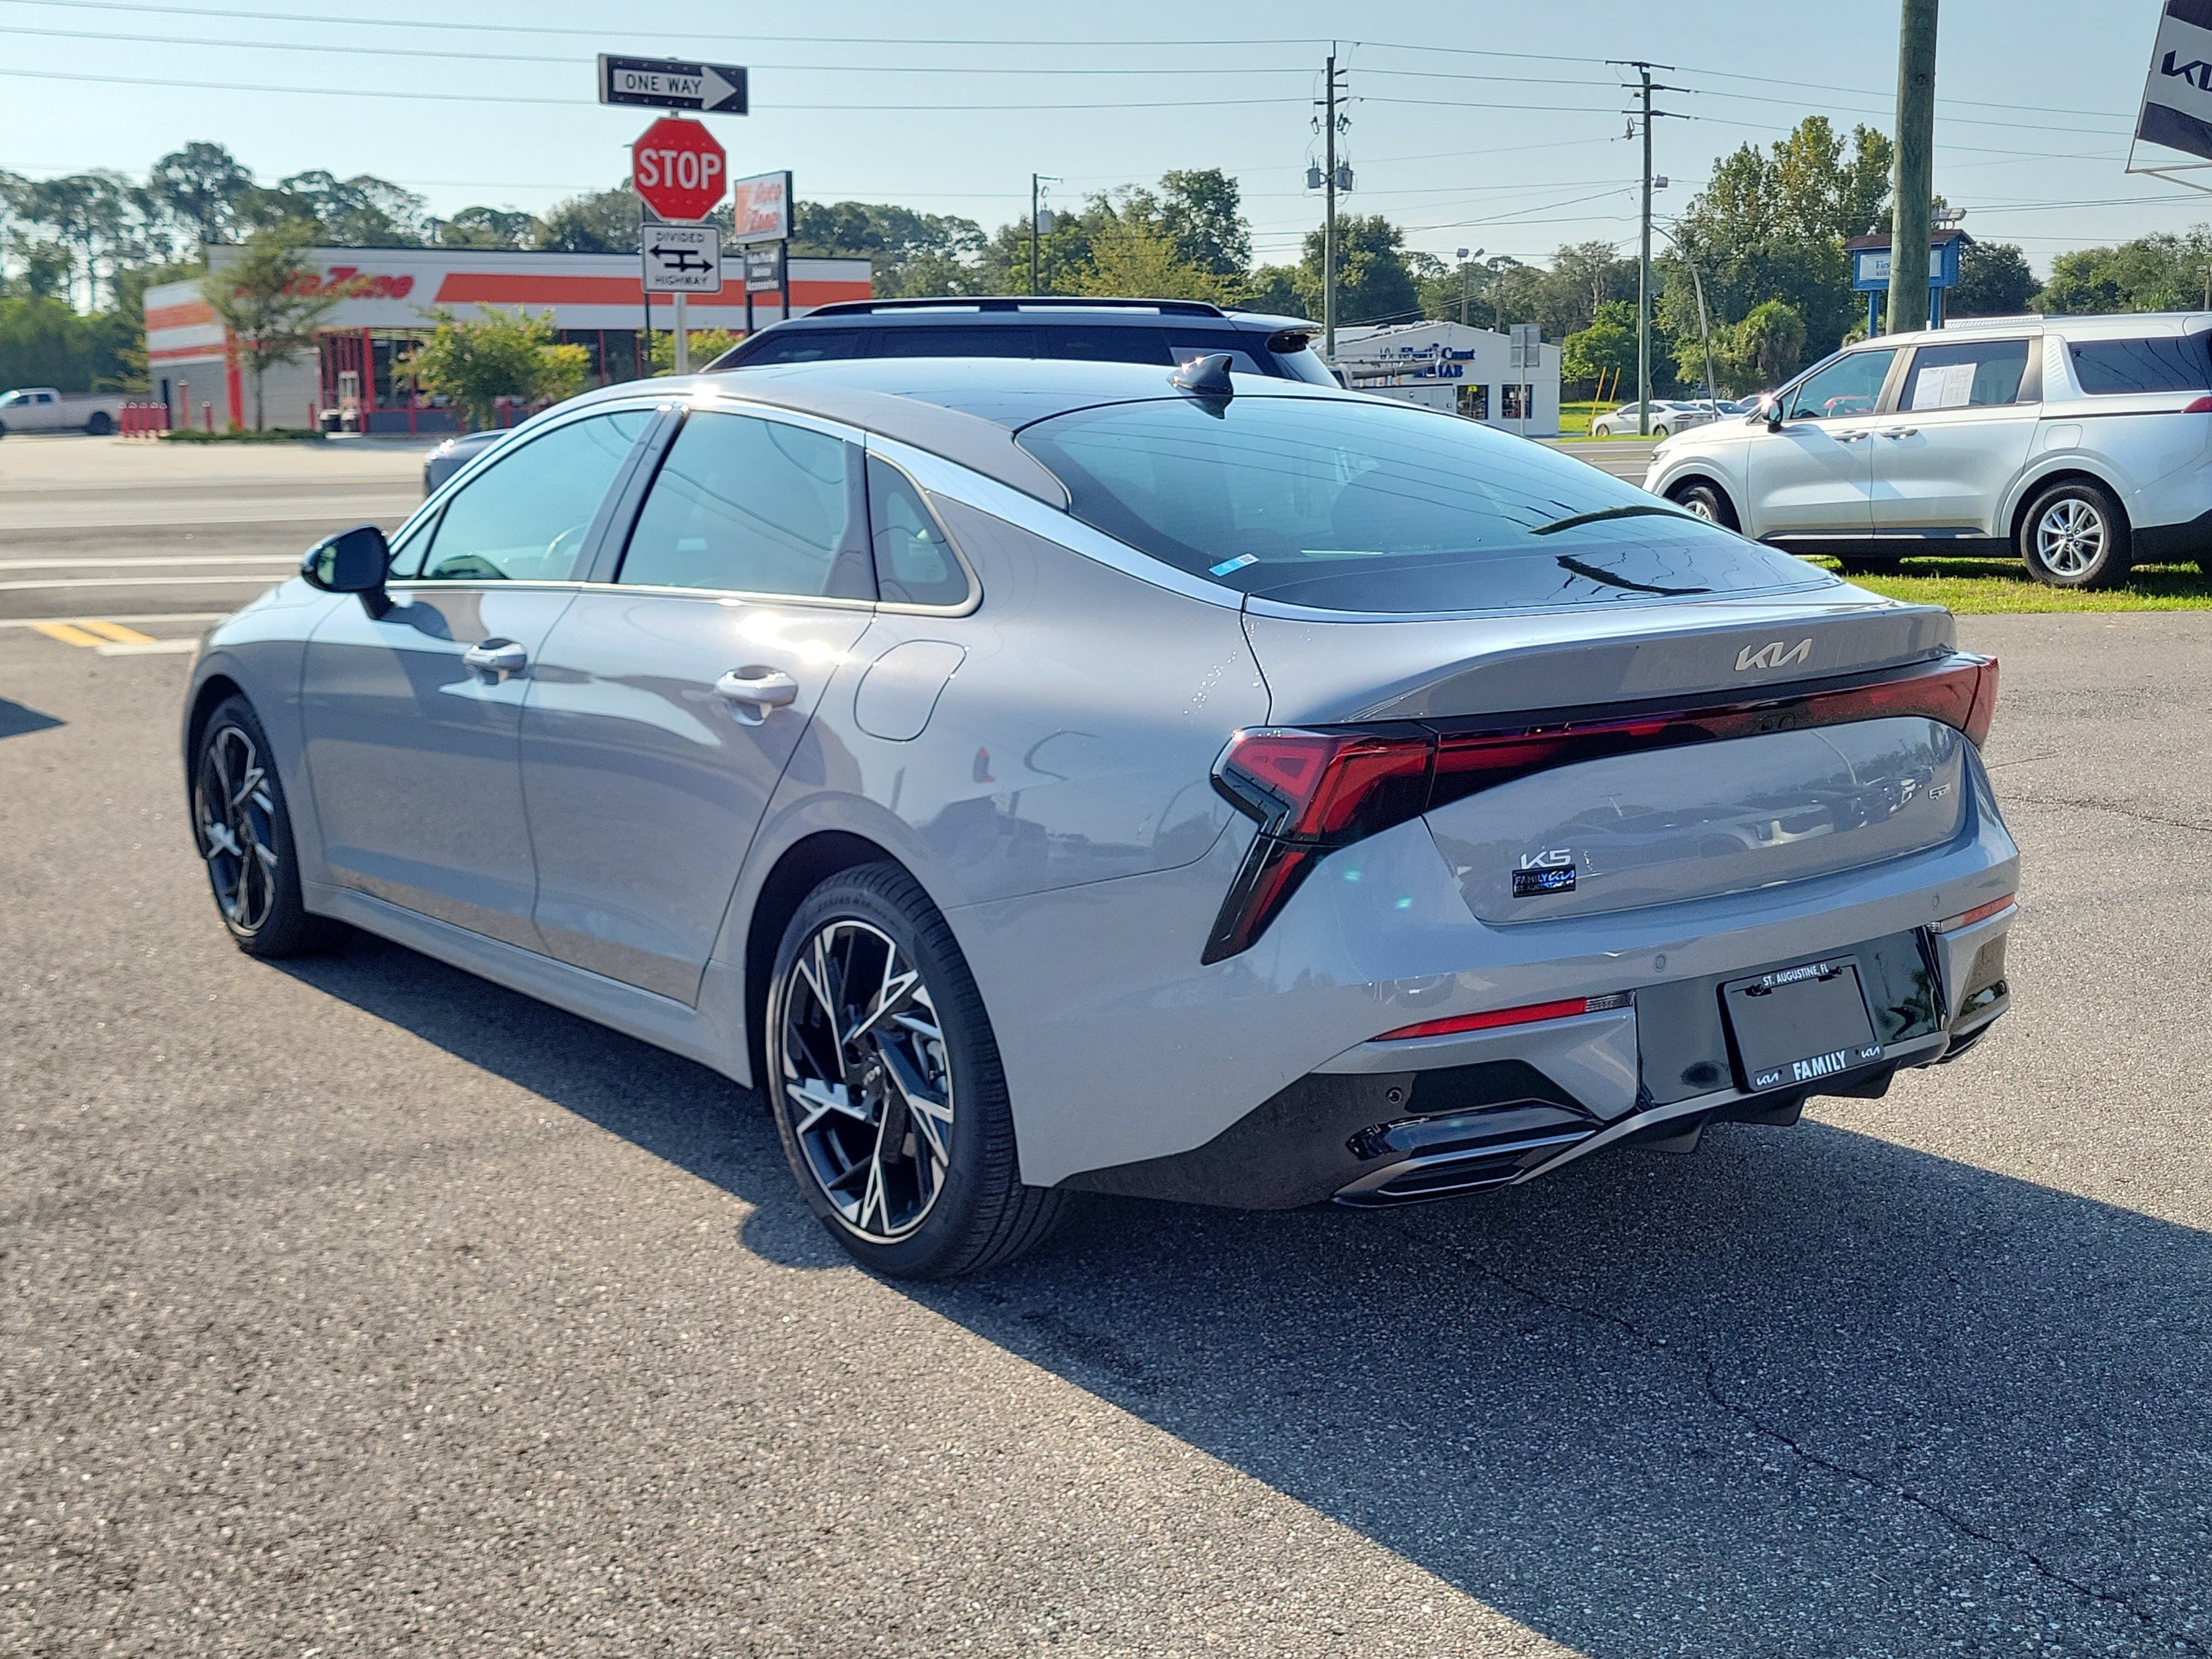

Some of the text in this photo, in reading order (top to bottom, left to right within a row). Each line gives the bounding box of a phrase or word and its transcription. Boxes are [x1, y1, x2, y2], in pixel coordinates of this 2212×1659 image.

[2161, 50, 2212, 92] KI
[625, 74, 702, 95] ONE WAY
[636, 148, 722, 190] STOP
[656, 232, 704, 243] DIVIDED
[654, 275, 707, 285] HIGHWAY
[1735, 639, 1812, 670] KIA
[1520, 849, 1571, 870] K5
[1515, 873, 1548, 885] FAMILY
[1762, 963, 1829, 986] ST. AUGUSTINE, FL
[1756, 1046, 1880, 1086] KIA FAMILY KIA
